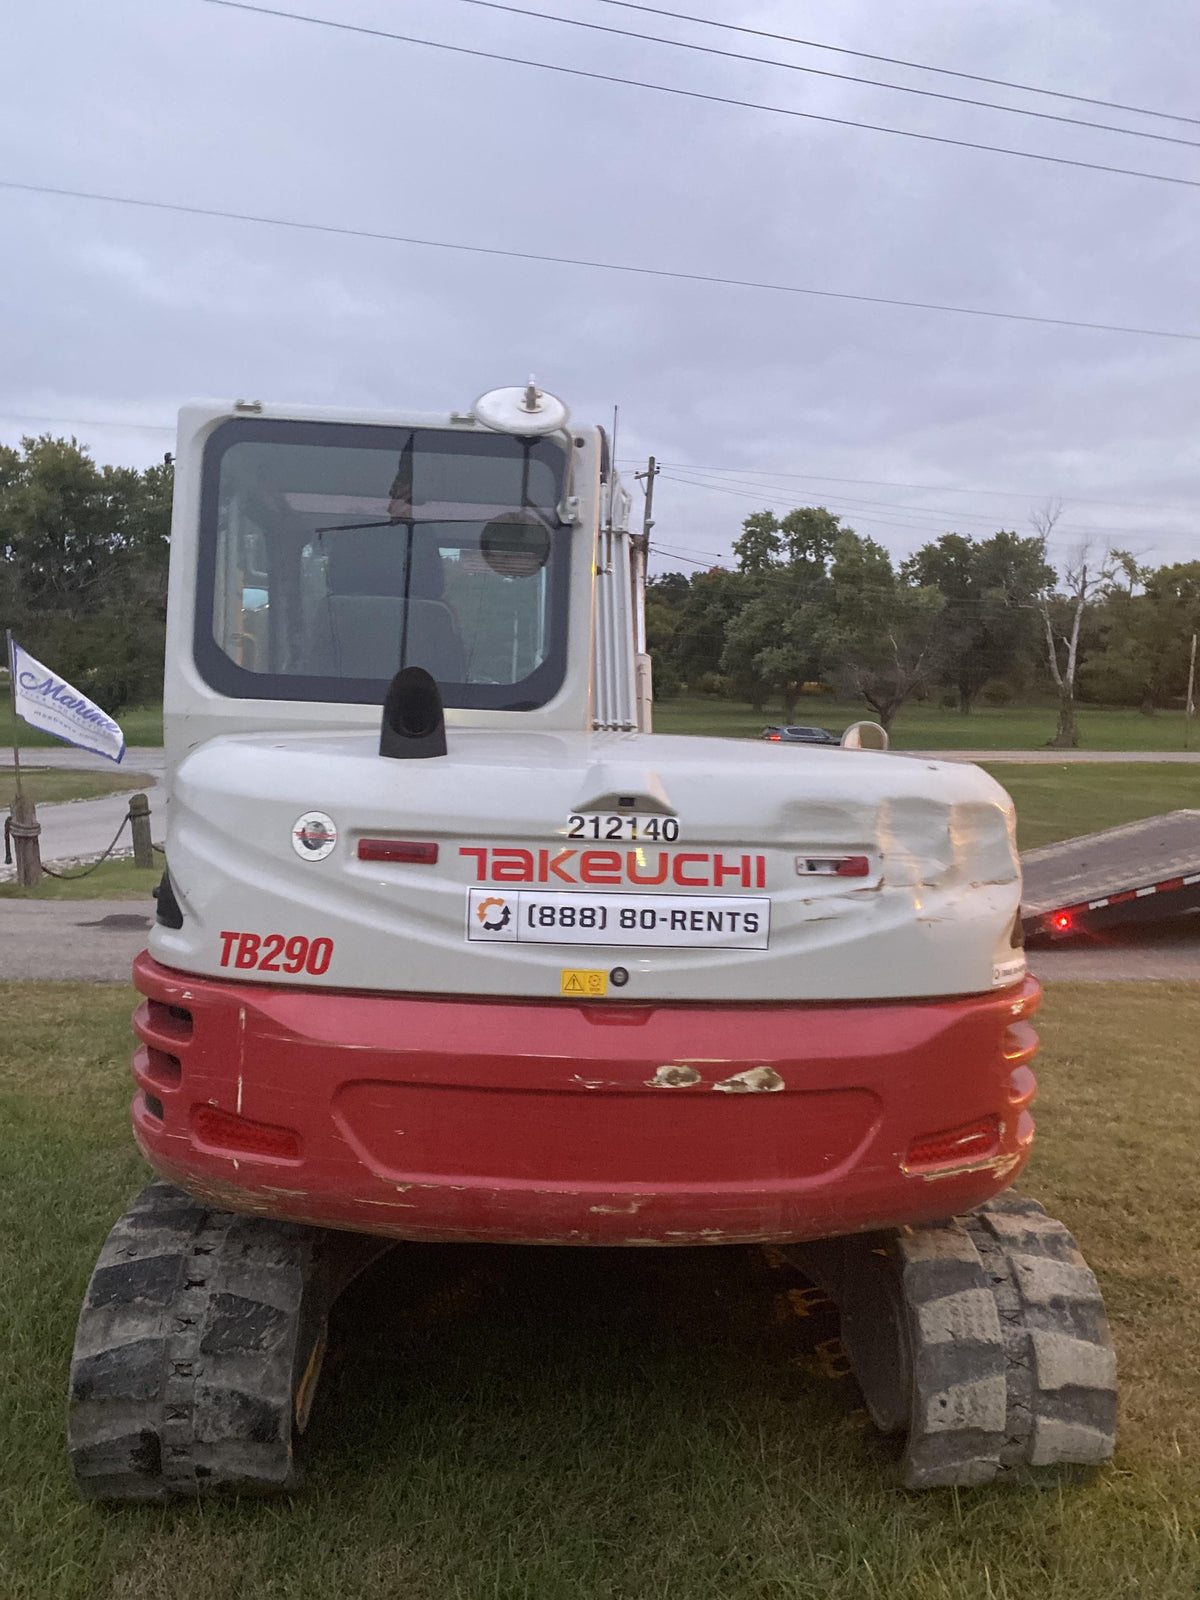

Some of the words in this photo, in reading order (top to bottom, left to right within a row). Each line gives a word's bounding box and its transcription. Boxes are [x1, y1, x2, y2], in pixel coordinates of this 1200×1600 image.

[566, 815, 680, 842] 212140
[527, 903, 607, 930] (888)
[619, 907, 760, 934] 80-RENTS
[219, 931, 335, 976] TB290
